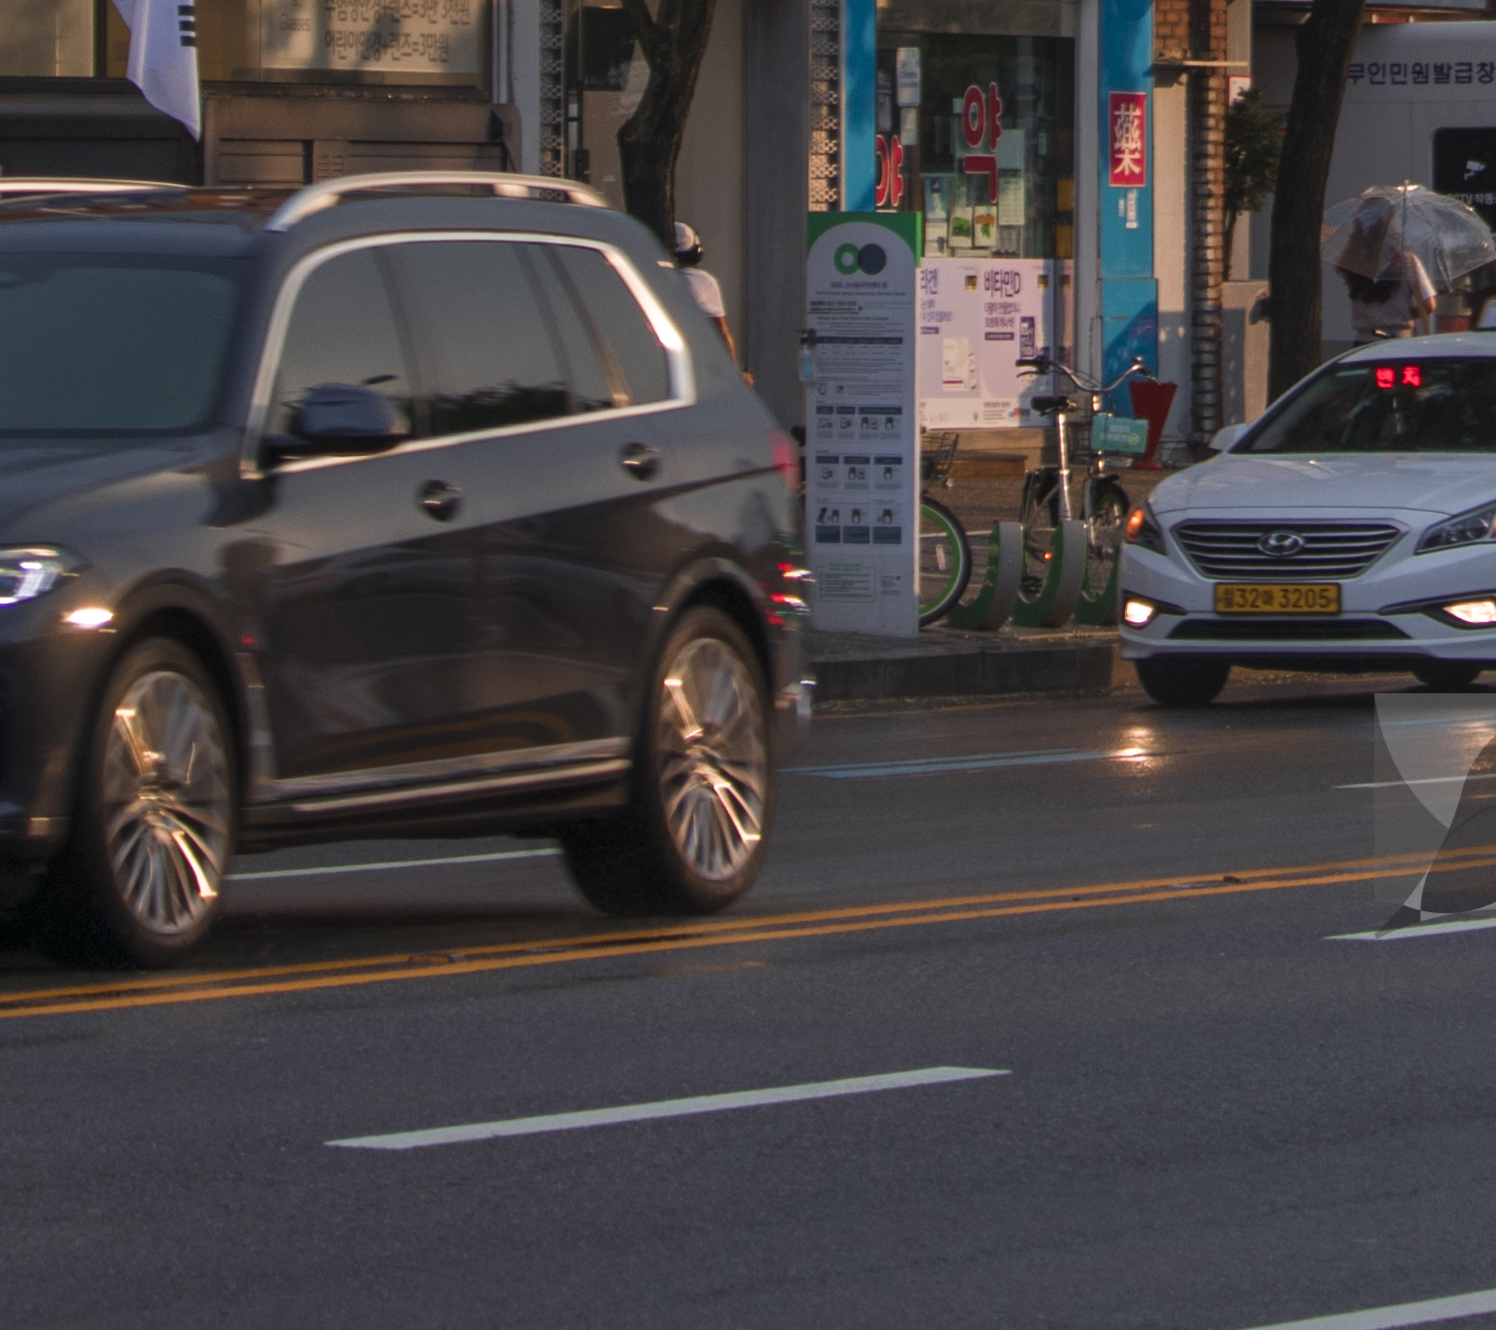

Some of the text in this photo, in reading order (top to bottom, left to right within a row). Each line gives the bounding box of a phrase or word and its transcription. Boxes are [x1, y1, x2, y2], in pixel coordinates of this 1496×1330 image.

[963, 81, 1003, 205] 약
[983, 268, 1022, 298] 비타민D
[1278, 587, 1331, 609] 3205
